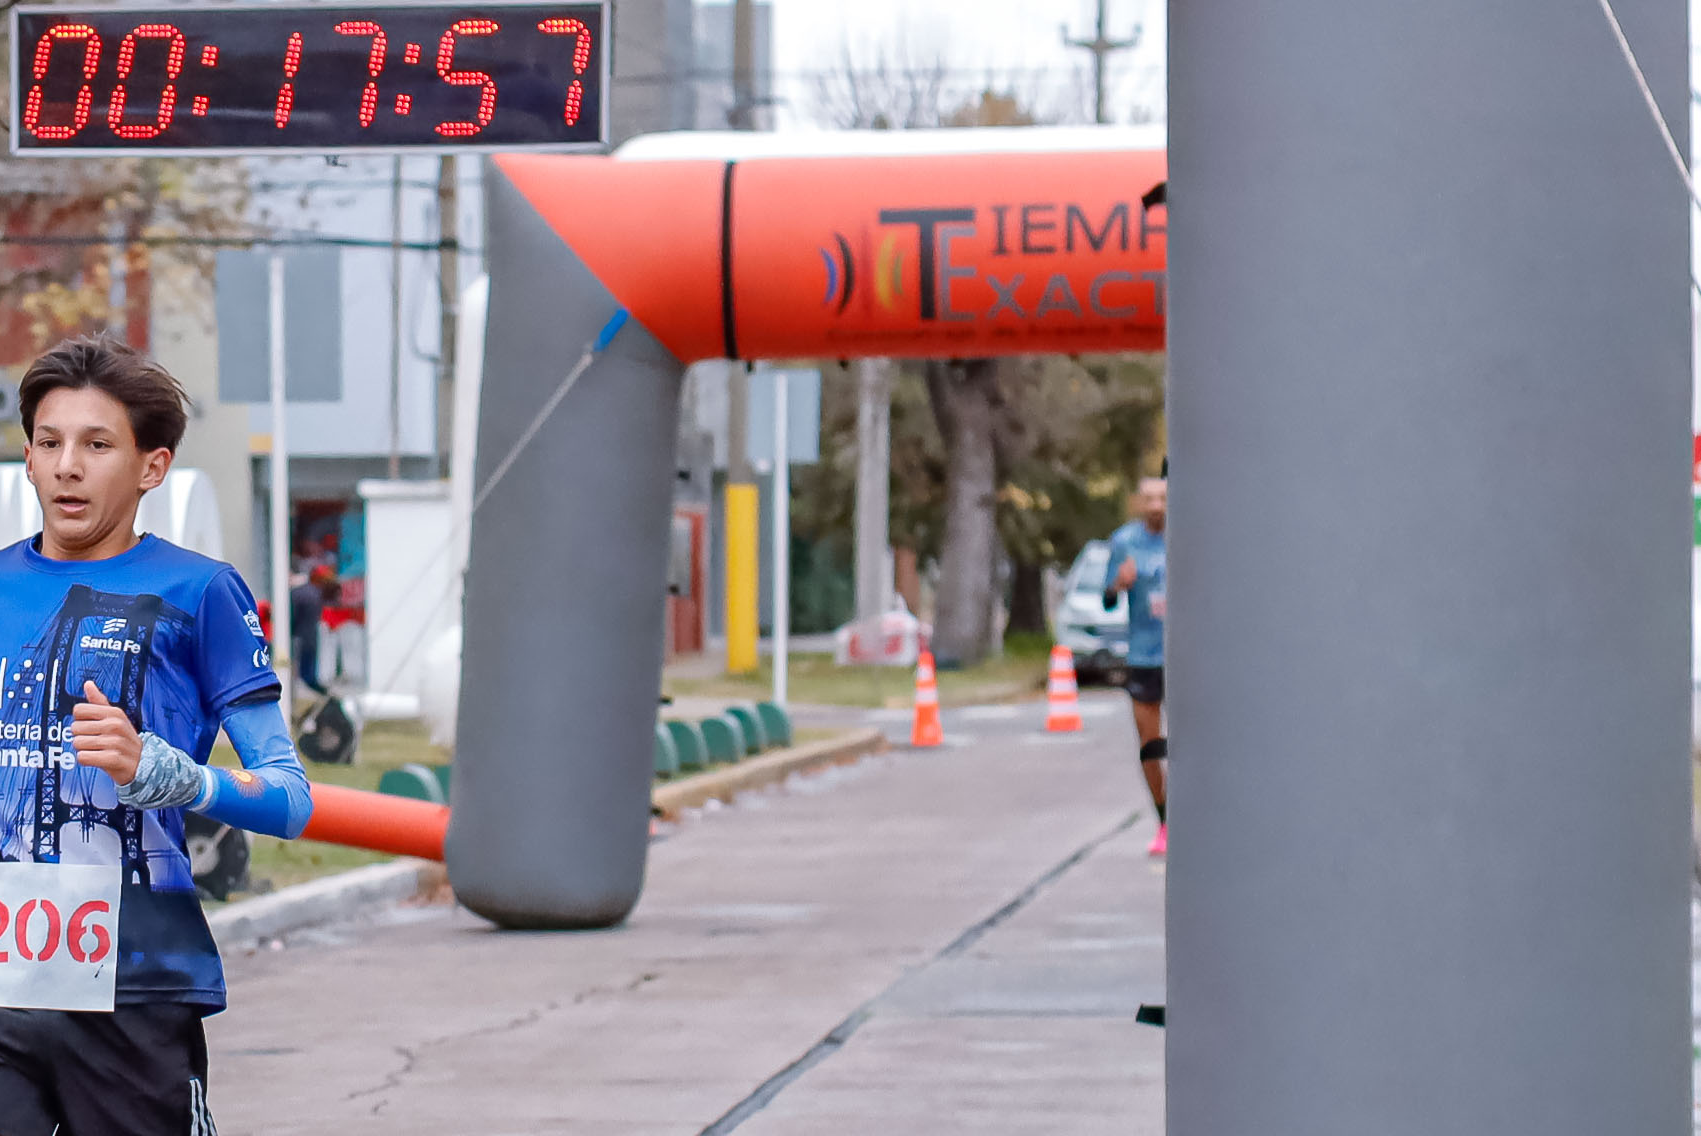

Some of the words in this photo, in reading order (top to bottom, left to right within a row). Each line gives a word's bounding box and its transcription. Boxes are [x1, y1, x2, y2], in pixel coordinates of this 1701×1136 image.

[24, 19, 592, 139] 00:17:57
[80, 635, 122, 651] Santa
[123, 639, 141, 654] Fe
[48, 721, 74, 742] de
[48, 746, 76, 770] Fe
